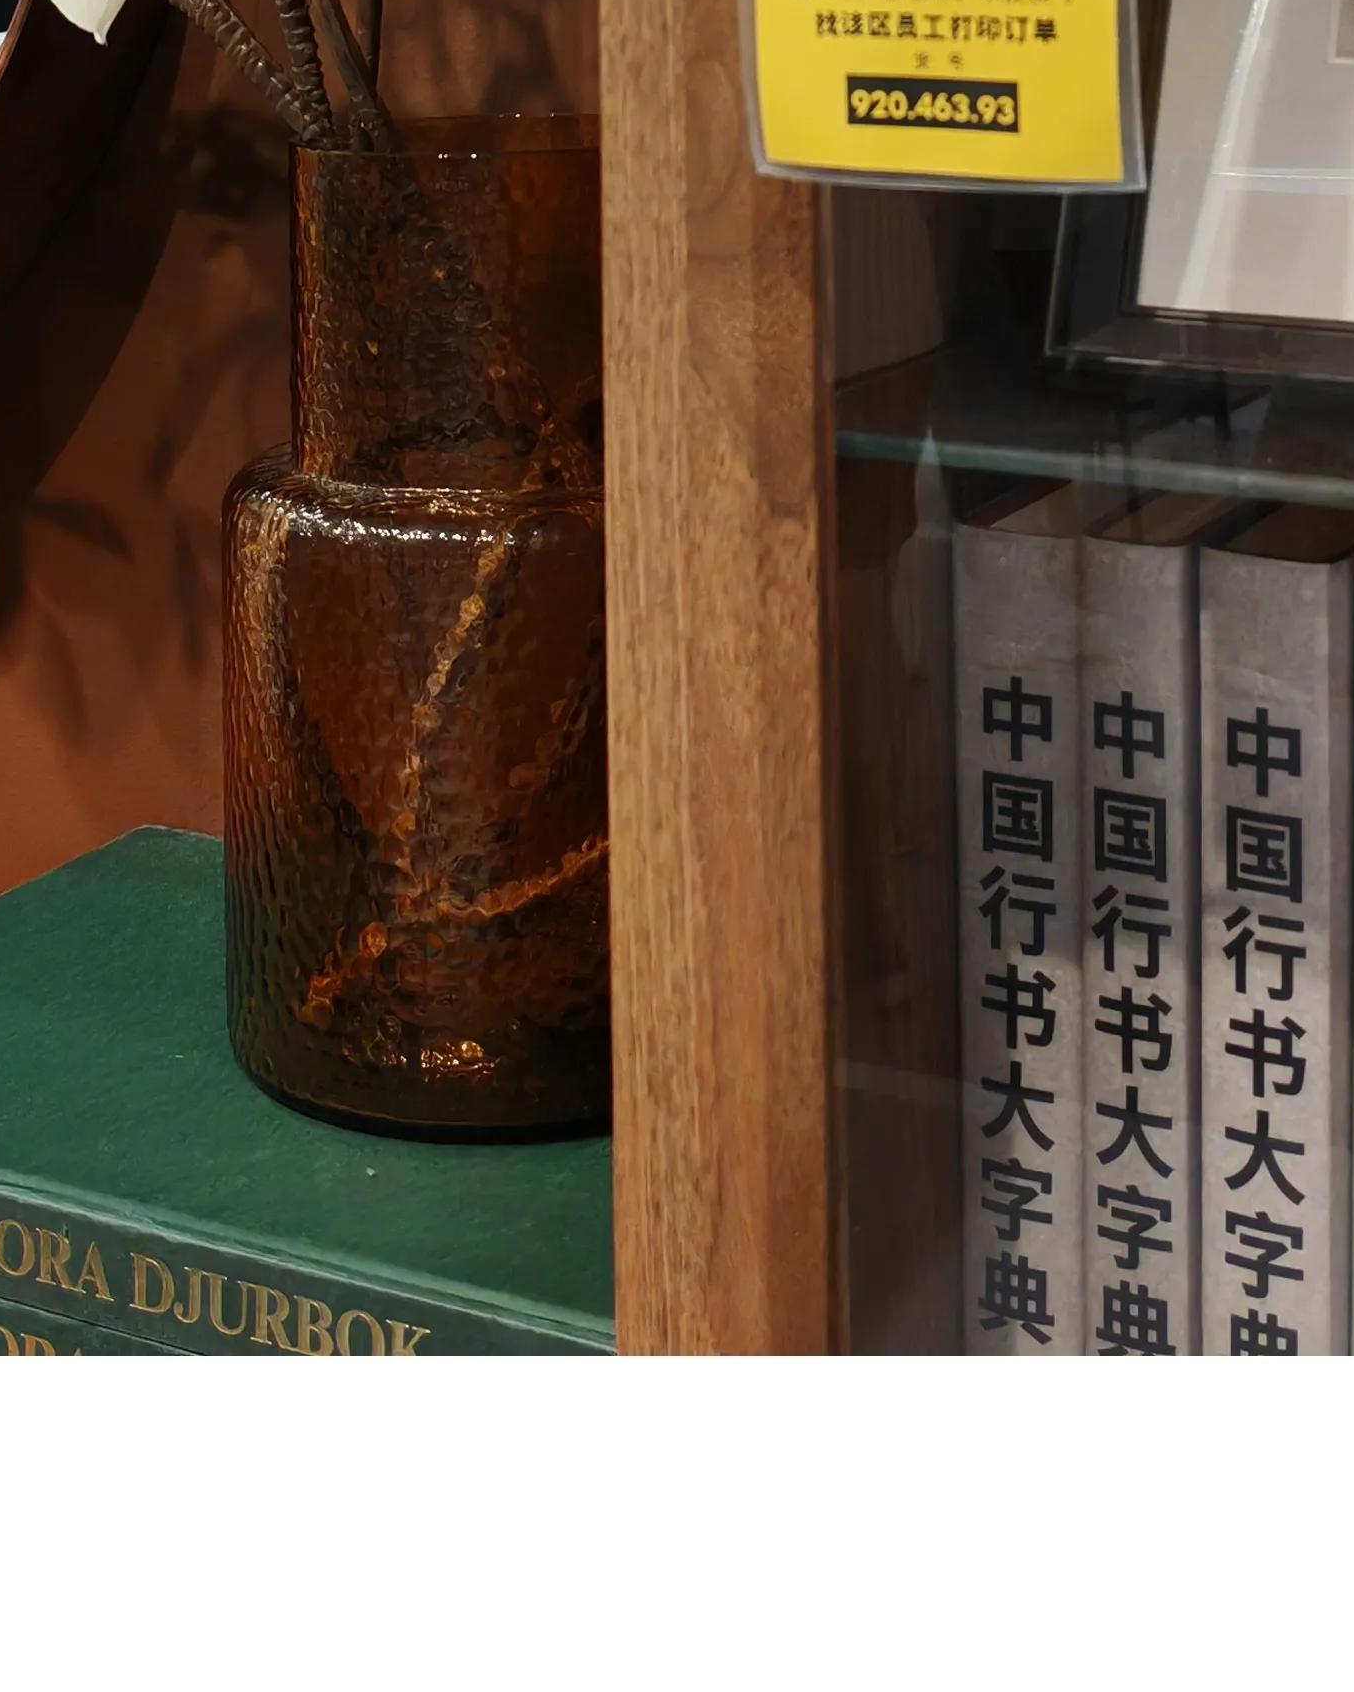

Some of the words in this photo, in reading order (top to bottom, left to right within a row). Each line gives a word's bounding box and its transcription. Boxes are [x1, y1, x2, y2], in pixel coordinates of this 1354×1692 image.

[815, 11, 1060, 43] 找该区员工打印订单
[850, 89, 1016, 126] 920.463.93
[978, 676, 1057, 1345] 中国行书大字典
[1092, 691, 1176, 1355] 中国行书大字典
[129, 1252, 432, 1355] DJURBOK
